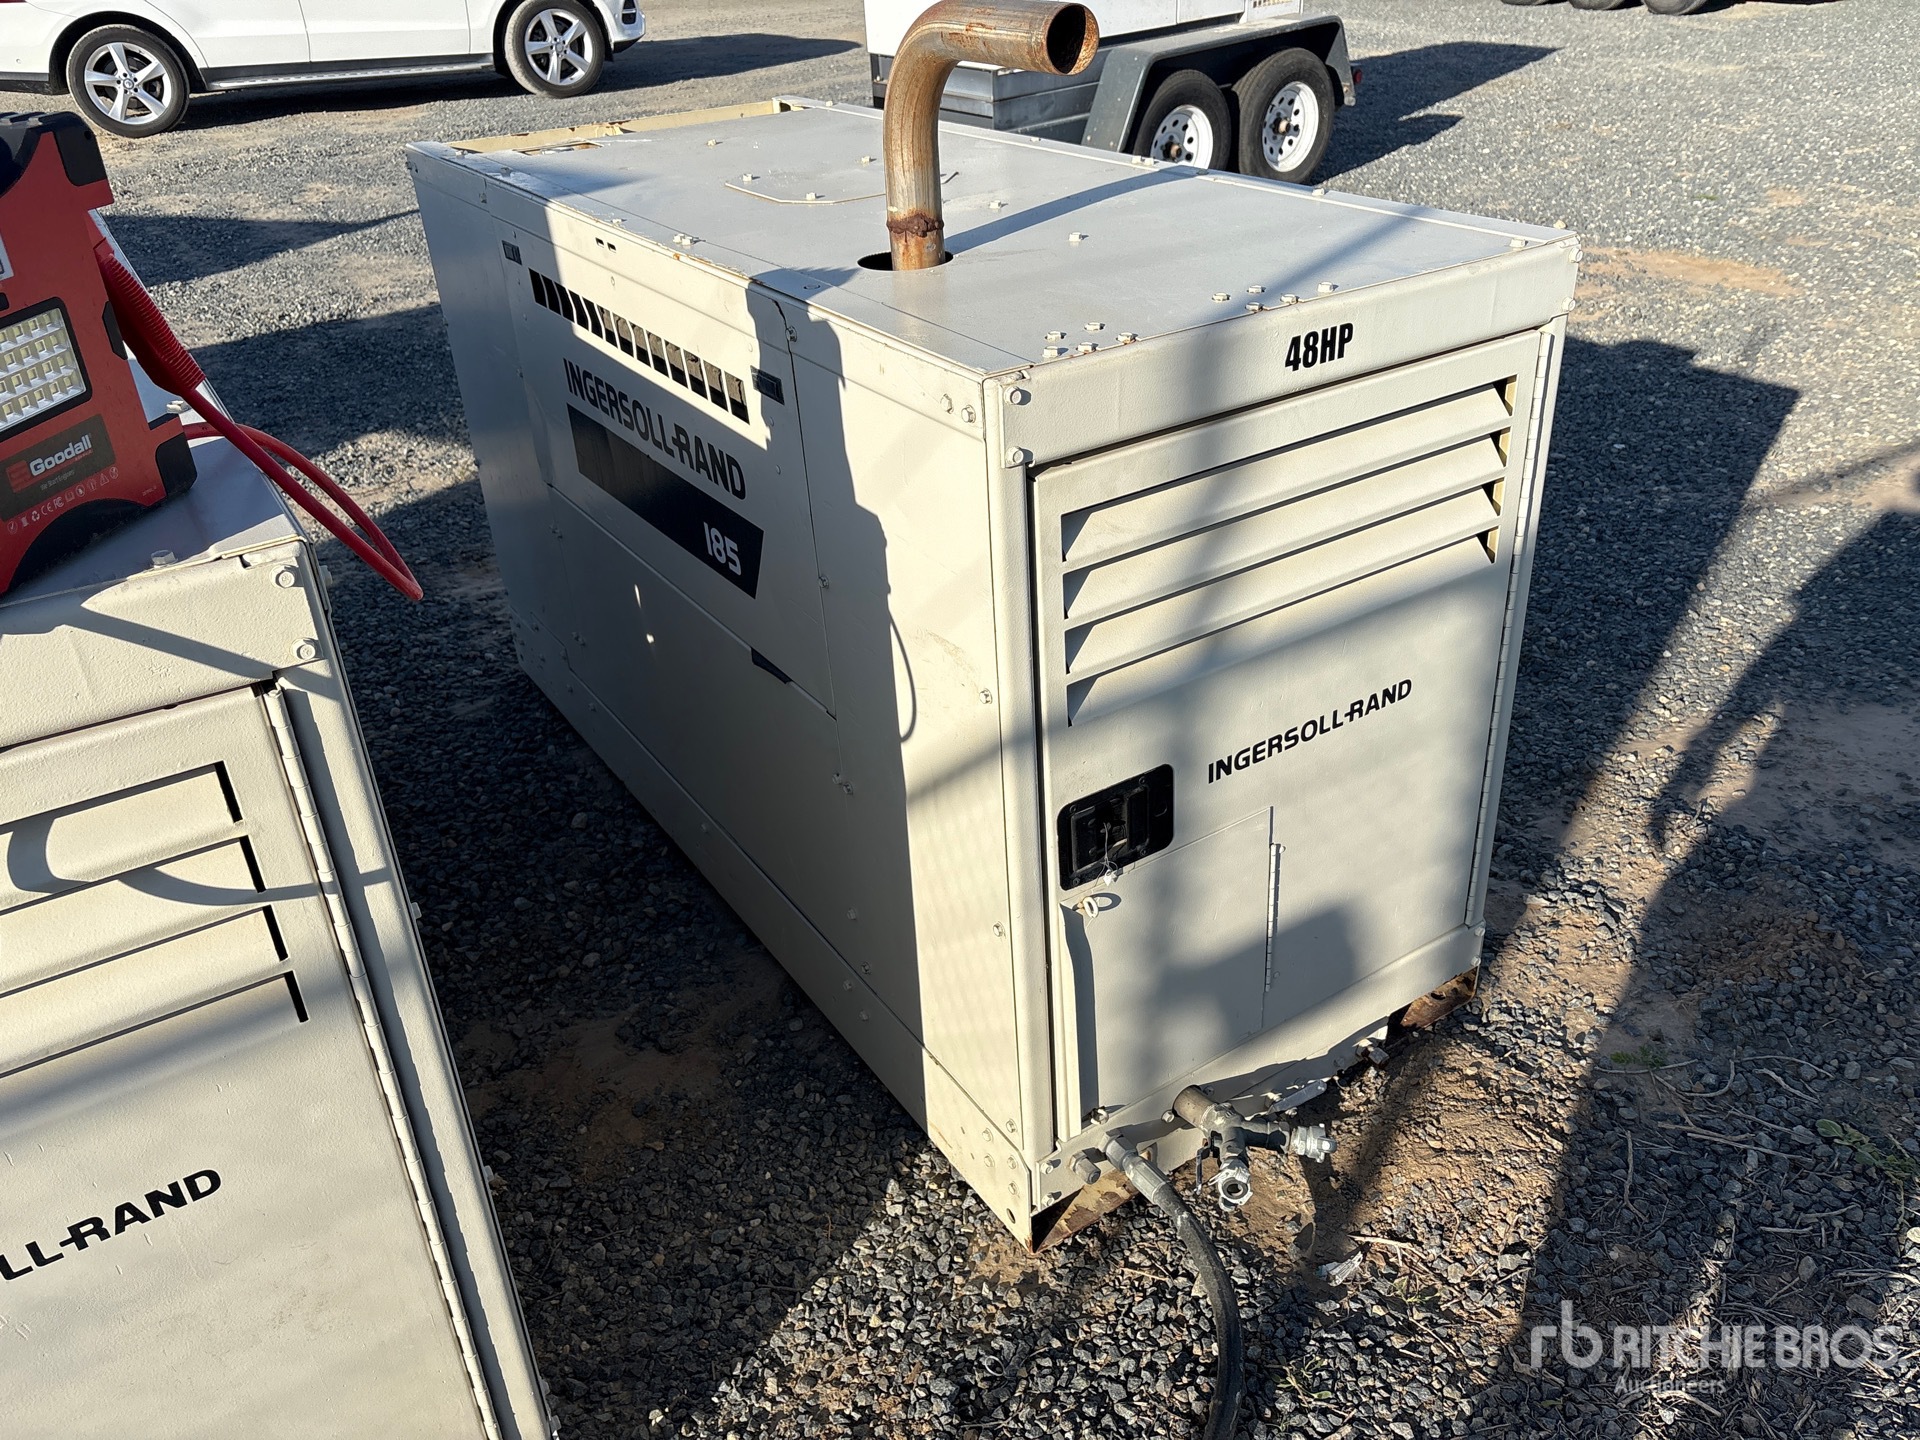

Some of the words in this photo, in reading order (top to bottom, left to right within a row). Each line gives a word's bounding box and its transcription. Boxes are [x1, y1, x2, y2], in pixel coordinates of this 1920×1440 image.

[1285, 322, 1353, 371] 48HP
[29, 434, 92, 476] Goodall
[563, 357, 746, 500] INGERSOLL-RAND
[703, 522, 741, 576] 185
[1208, 679, 1412, 784] INGERSOLL-RAND
[0, 1169, 221, 1280] LL-RAND
